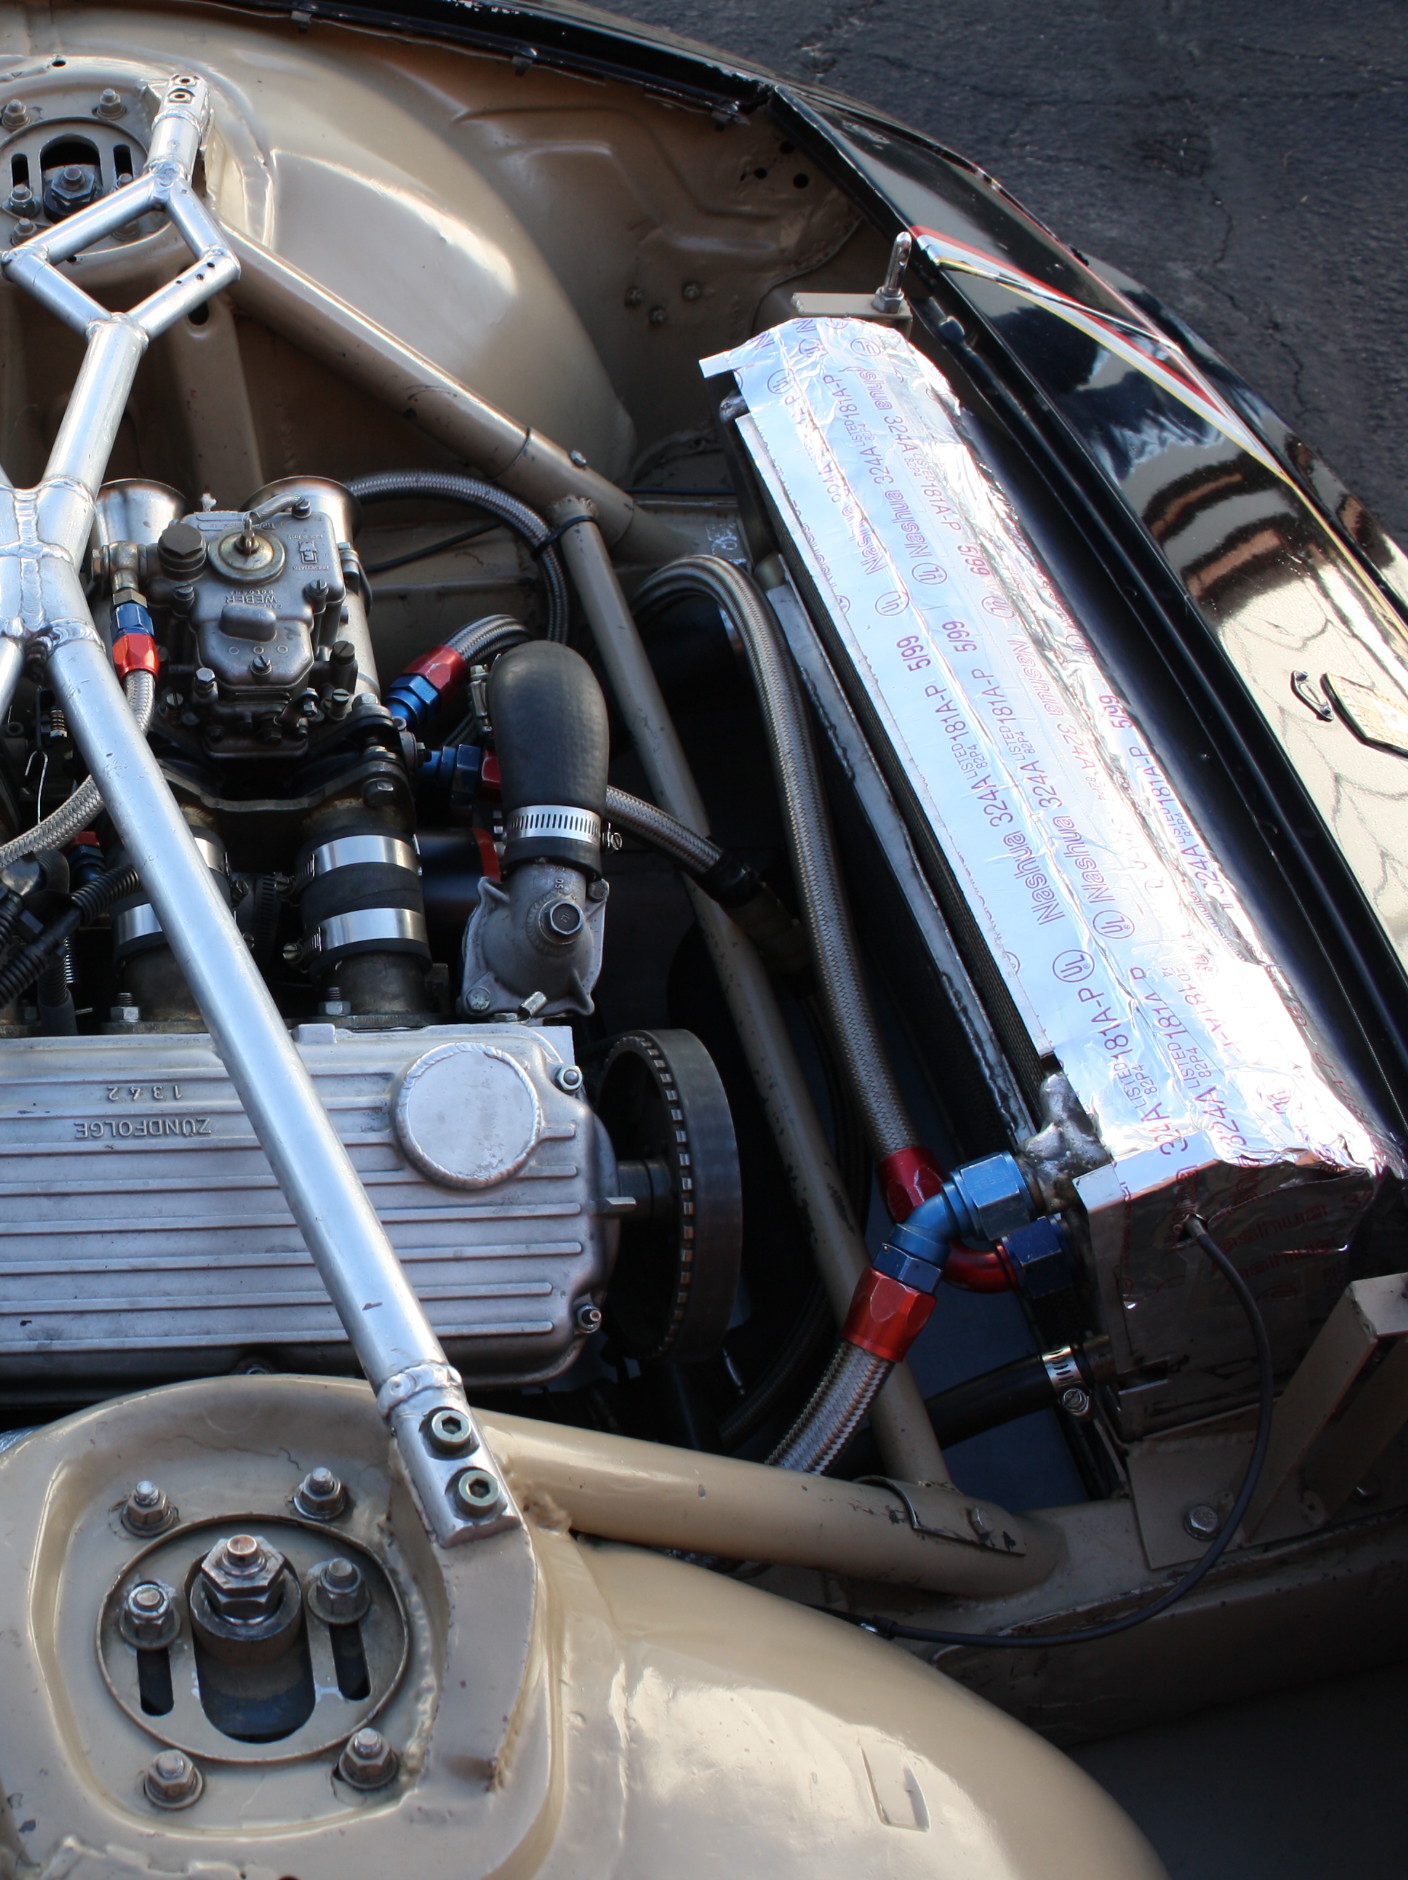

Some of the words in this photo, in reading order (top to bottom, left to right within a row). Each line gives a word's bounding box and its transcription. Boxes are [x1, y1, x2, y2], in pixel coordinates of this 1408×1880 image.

[821, 371, 860, 418] 181A-P
[843, 419, 866, 447] LISTED
[858, 443, 895, 485] 324A
[877, 486, 933, 560] Nashua
[882, 416, 918, 454] 324A
[919, 481, 962, 533] 181A-P
[956, 543, 992, 579] 5/99
[1005, 640, 1065, 717] Nashua
[225, 594, 279, 605] WEBER
[894, 632, 933, 673] 5/99
[940, 617, 978, 655] 5/99
[922, 680, 970, 743] 181A-P
[969, 665, 1017, 725] 181A-P
[949, 741, 978, 780] LISTED
[966, 742, 988, 770] 82P4
[996, 723, 1026, 761] LISTED
[1013, 729, 1036, 755] 82P4
[1018, 758, 1063, 807] 324A
[1127, 744, 1175, 803] 181A-P
[968, 773, 1015, 830] 324A
[995, 828, 1066, 927] Nashua
[1046, 813, 1116, 905] Nashua
[1075, 980, 1134, 1060] 181A-P
[1112, 1059, 1148, 1109] LISTED
[1129, 1061, 1159, 1096] 82P4
[1166, 1039, 1201, 1090] LISTED
[1185, 1045, 1212, 1079] 82P4
[73, 1117, 212, 1139] ZÜNDFOLGE
